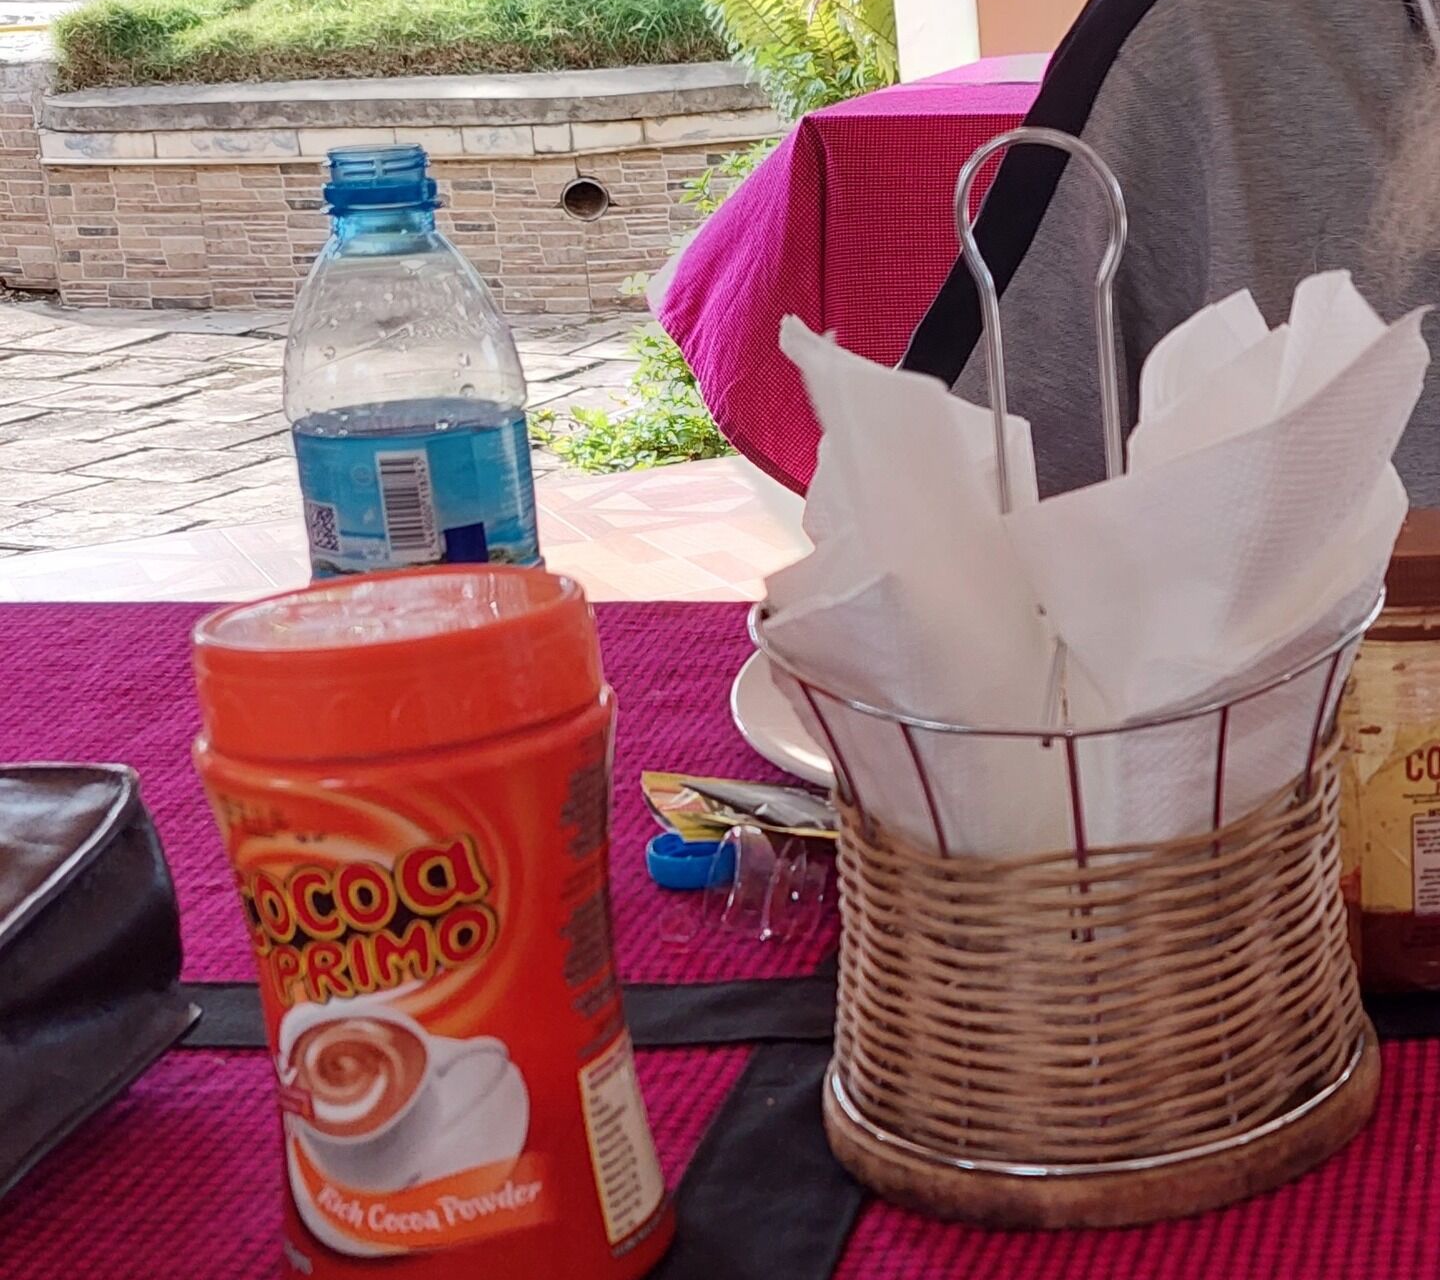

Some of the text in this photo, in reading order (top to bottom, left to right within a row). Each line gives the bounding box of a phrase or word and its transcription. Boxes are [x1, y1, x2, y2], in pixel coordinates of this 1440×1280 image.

[269, 903, 497, 1006] PRIMO
[316, 1180, 543, 1234] Rich Cocoa Powder
